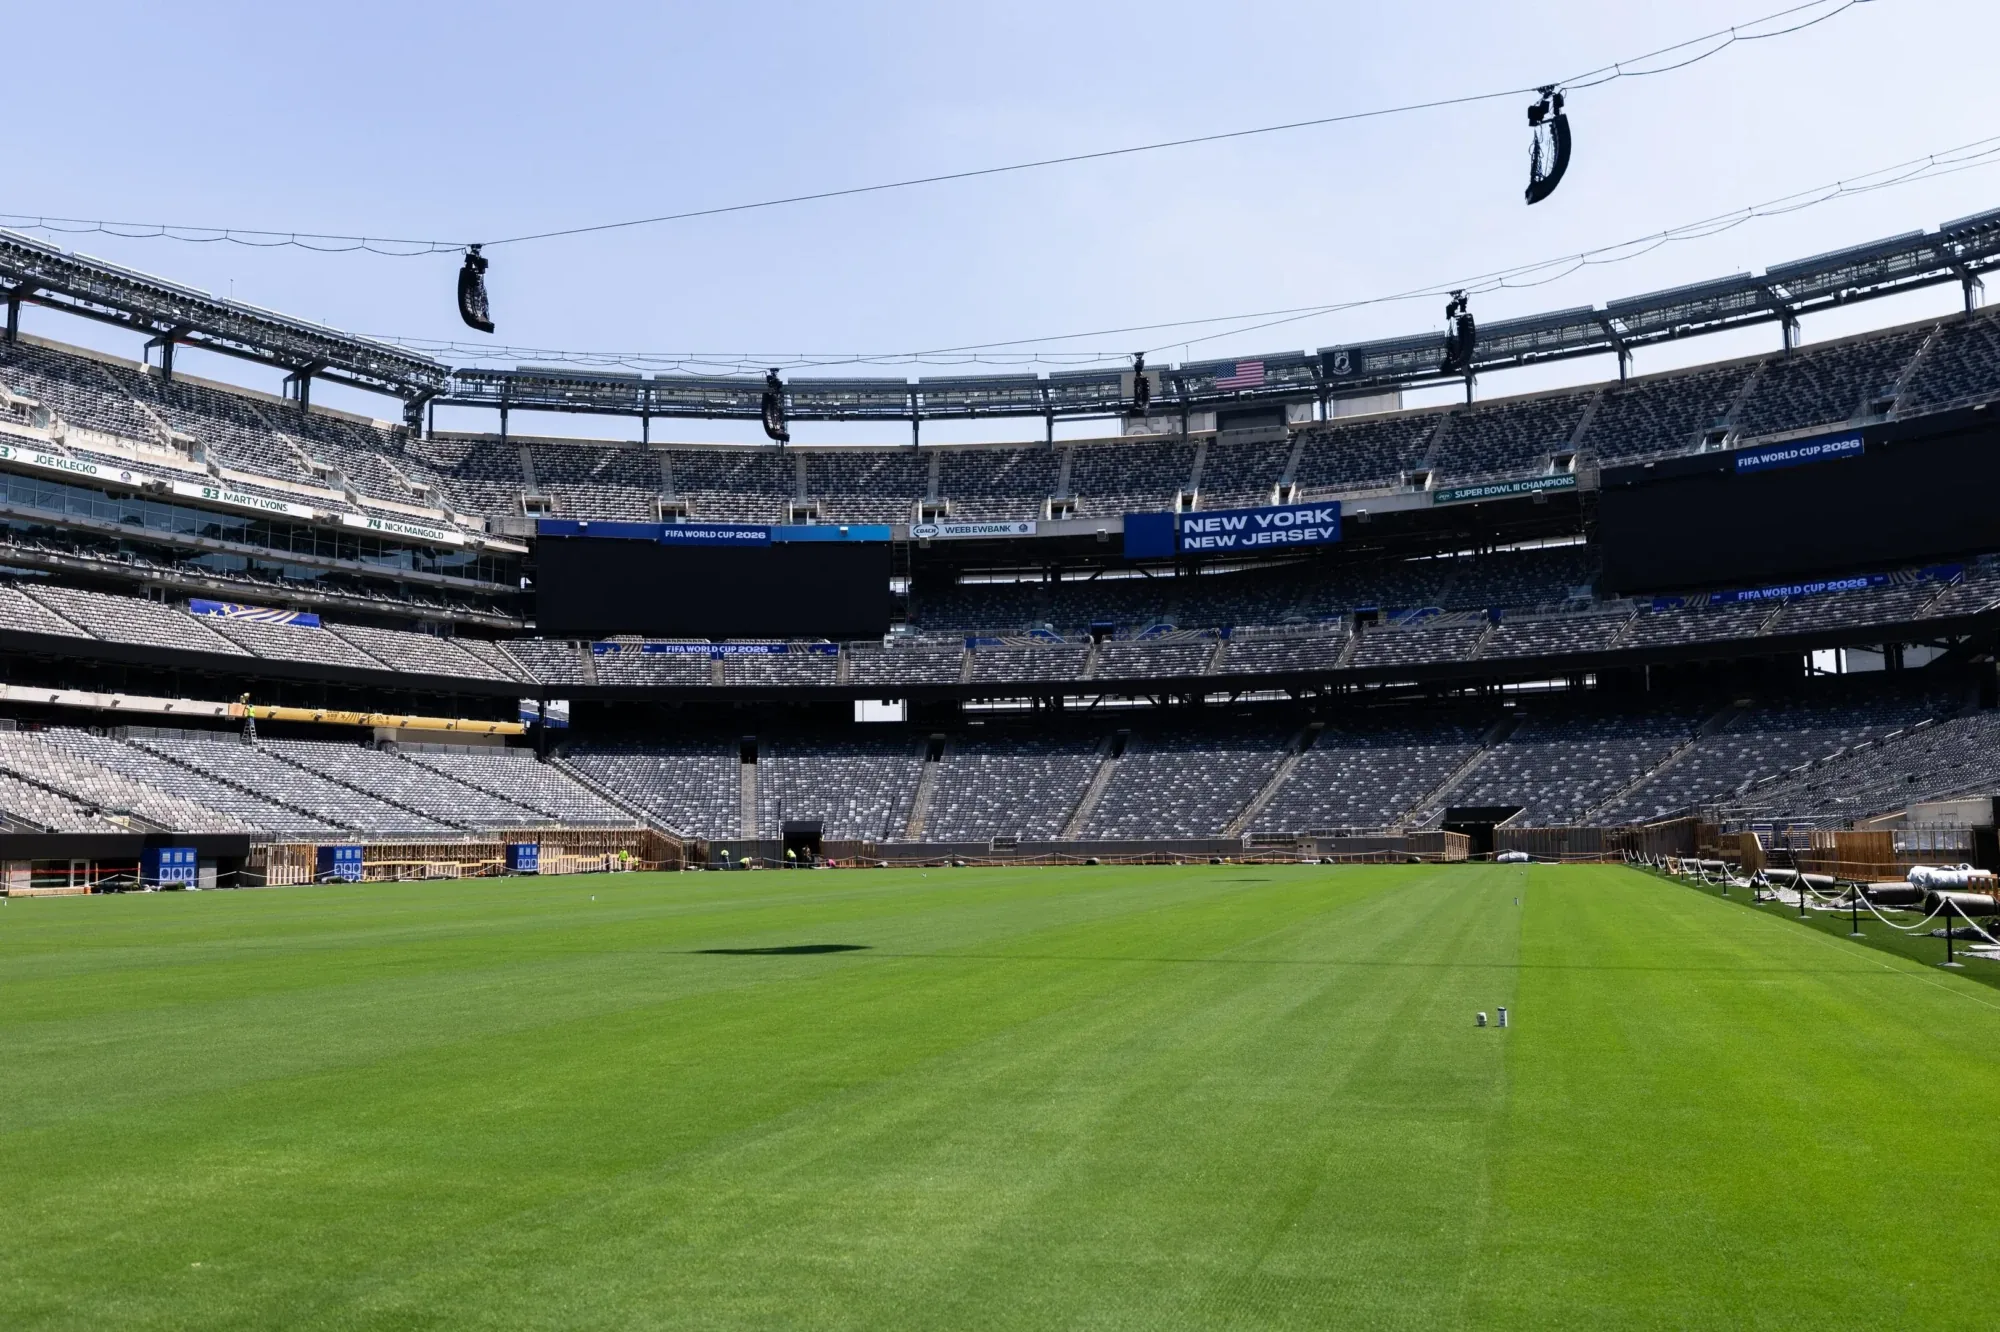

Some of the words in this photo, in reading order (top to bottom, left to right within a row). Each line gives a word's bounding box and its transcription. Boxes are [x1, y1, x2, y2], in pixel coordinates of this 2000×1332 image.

[34, 454, 54, 466] JOE
[56, 459, 97, 474] KLECKO
[1738, 456, 1760, 466] FIFA
[1760, 450, 1798, 462] WORLD
[1800, 446, 1820, 456] CUP
[1822, 440, 1860, 453] 2026
[1454, 488, 1482, 498] SUPER
[1484, 485, 1512, 494] BOWL
[1521, 476, 1574, 490] CHAMPIONS
[202, 488, 220, 500] 93
[224, 493, 258, 506] MARTY
[260, 500, 288, 512] LYONS
[366, 518, 382, 529] 74
[385, 522, 402, 532] NICK
[404, 526, 444, 540] MANGOLD
[972, 525, 1011, 533] EWBANK
[1184, 516, 1248, 533] NEW
[1254, 508, 1334, 528] YORK
[1184, 534, 1236, 548] NEW
[1242, 526, 1334, 546] JERSEY
[1738, 590, 1760, 600] FIFA
[1762, 586, 1802, 598] WORLD
[1802, 583, 1826, 593] CUP
[1827, 578, 1868, 590] 2026
